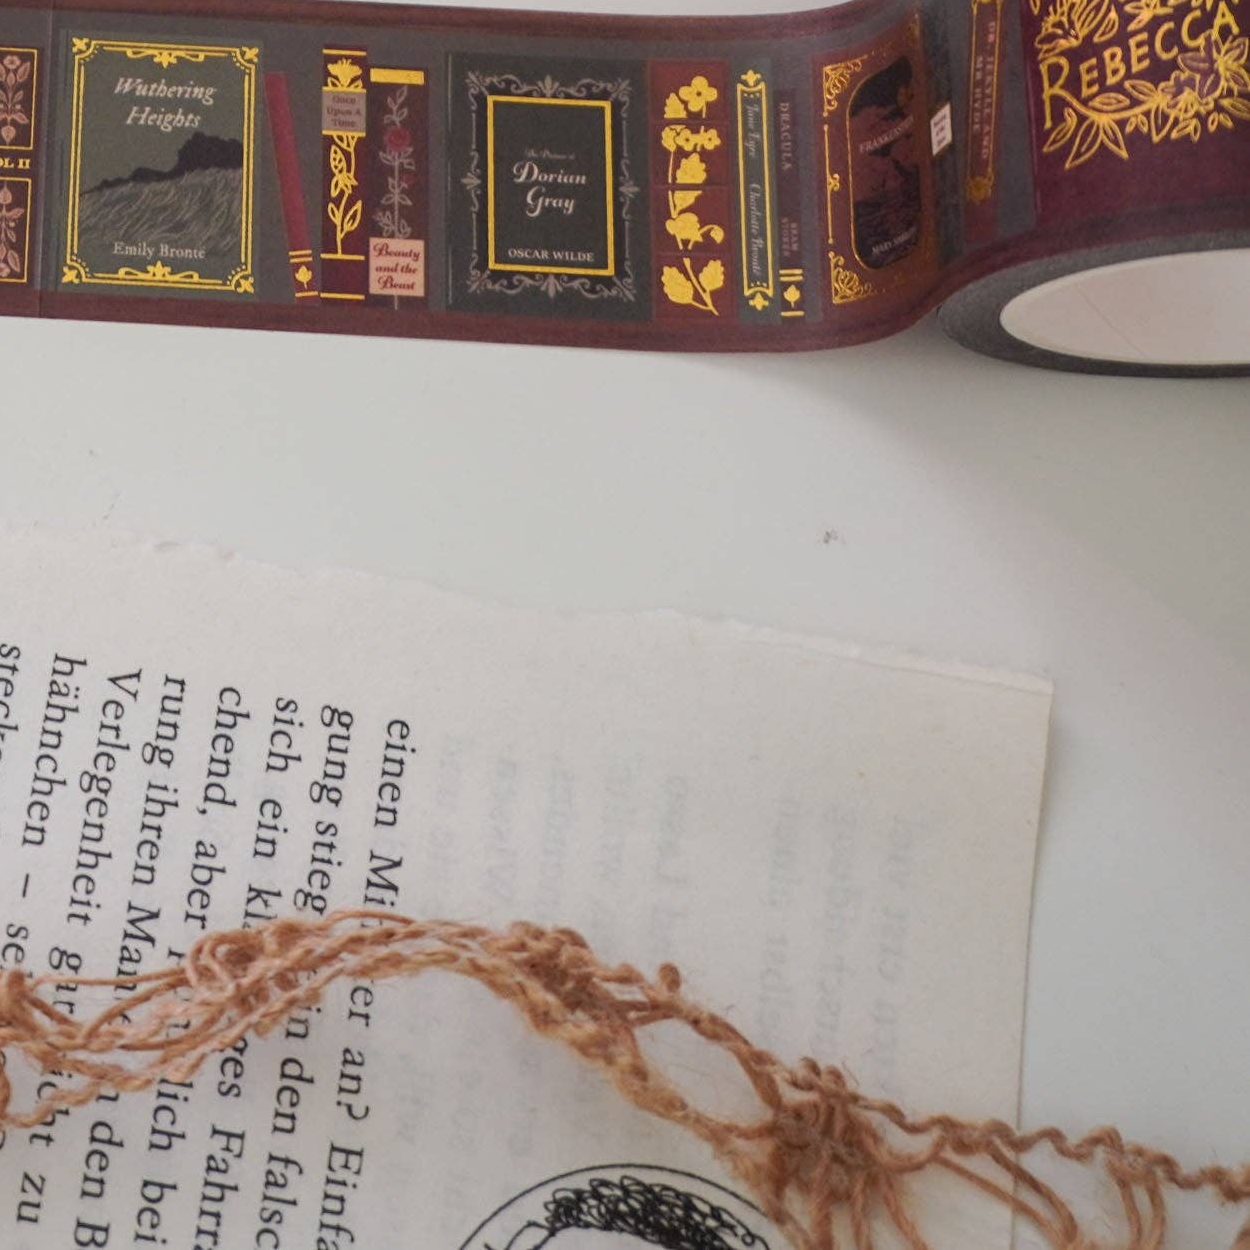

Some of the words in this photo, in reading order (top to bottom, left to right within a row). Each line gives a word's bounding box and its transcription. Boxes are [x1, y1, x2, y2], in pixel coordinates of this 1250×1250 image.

[1039, 0, 1240, 130] REBECCA
[113, 77, 217, 106] Wuthering
[125, 106, 201, 132] Heights
[779, 102, 792, 171] DRACULA
[17, 157, 31, 170] II
[512, 161, 587, 184] Dorian
[525, 185, 575, 217] Gray
[112, 241, 155, 259] Emily
[372, 242, 421, 261] Beauty
[508, 247, 549, 260] OSCAR
[552, 250, 595, 262] WILDE
[375, 263, 398, 274] and
[400, 263, 418, 275] the
[377, 275, 415, 291] Beast
[265, 697, 303, 771] sich
[374, 719, 416, 826] einen
[66, 668, 142, 925] Verlegenheit
[252, 798, 287, 858] ein
[293, 820, 342, 915] stieg
[271, 1057, 314, 1134] den
